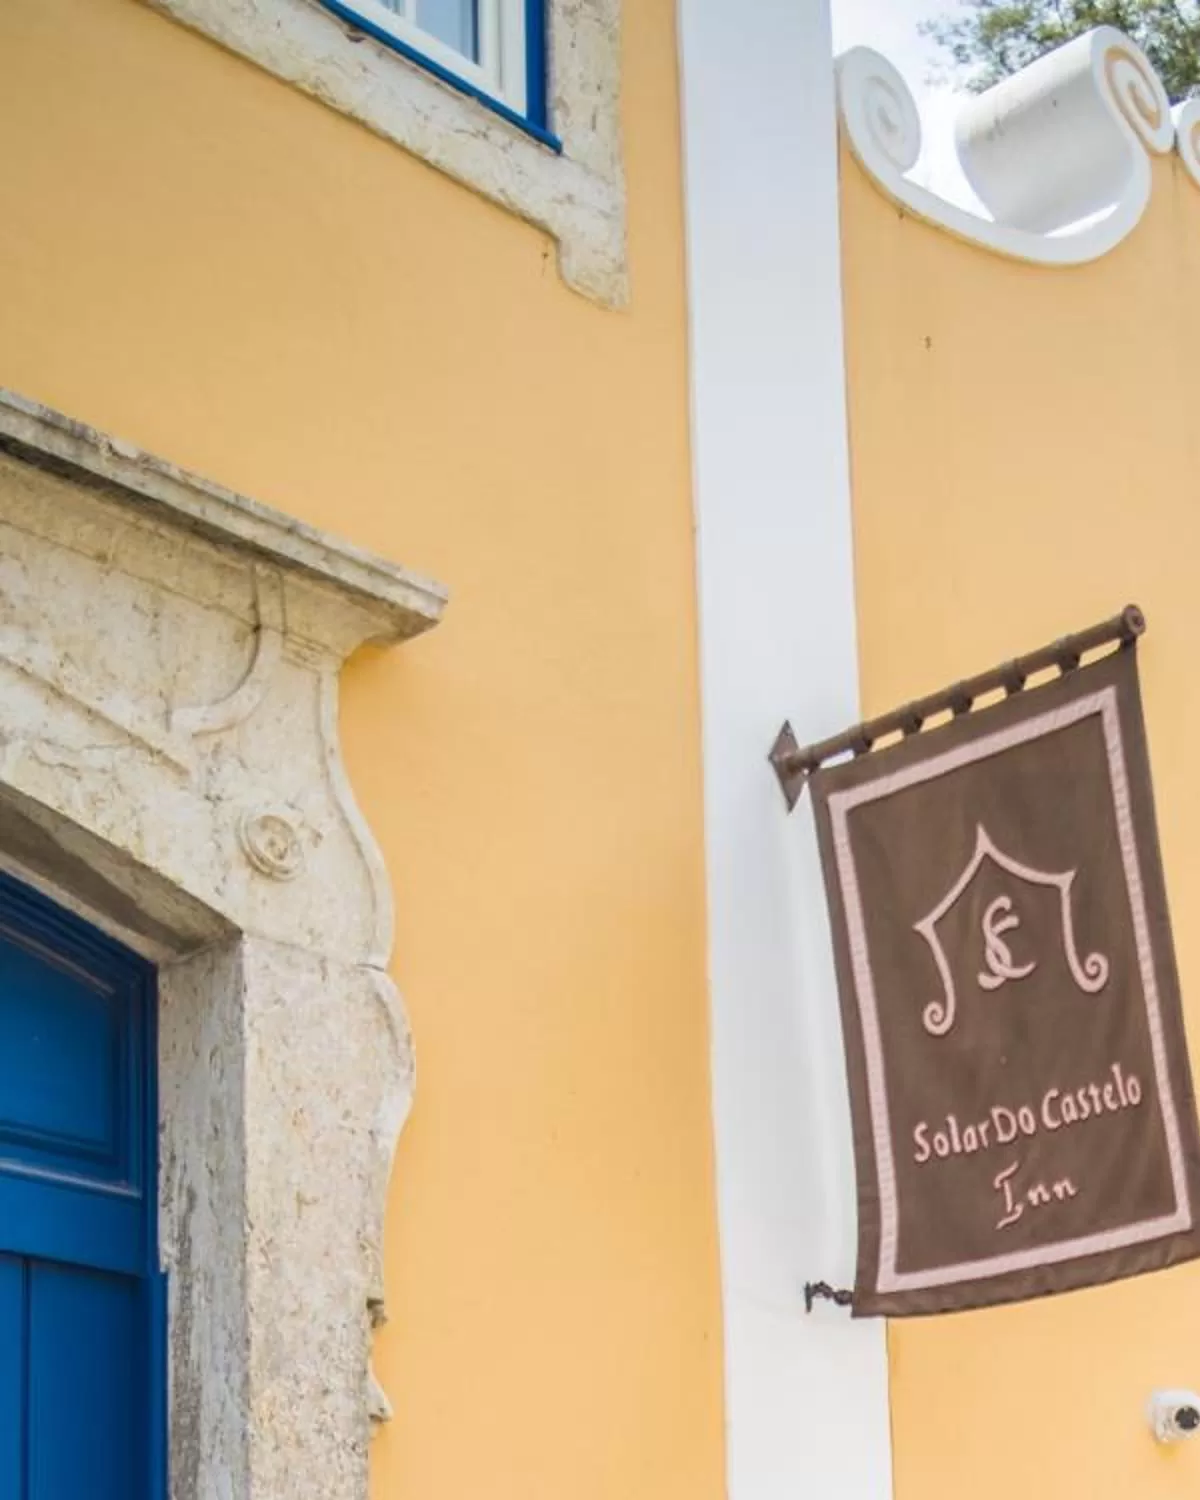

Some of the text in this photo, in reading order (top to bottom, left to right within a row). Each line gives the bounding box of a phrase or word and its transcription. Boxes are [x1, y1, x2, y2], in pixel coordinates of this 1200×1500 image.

[913, 1062, 1142, 1163] Solar Do Castelo
[993, 1160, 1078, 1229] Inn
